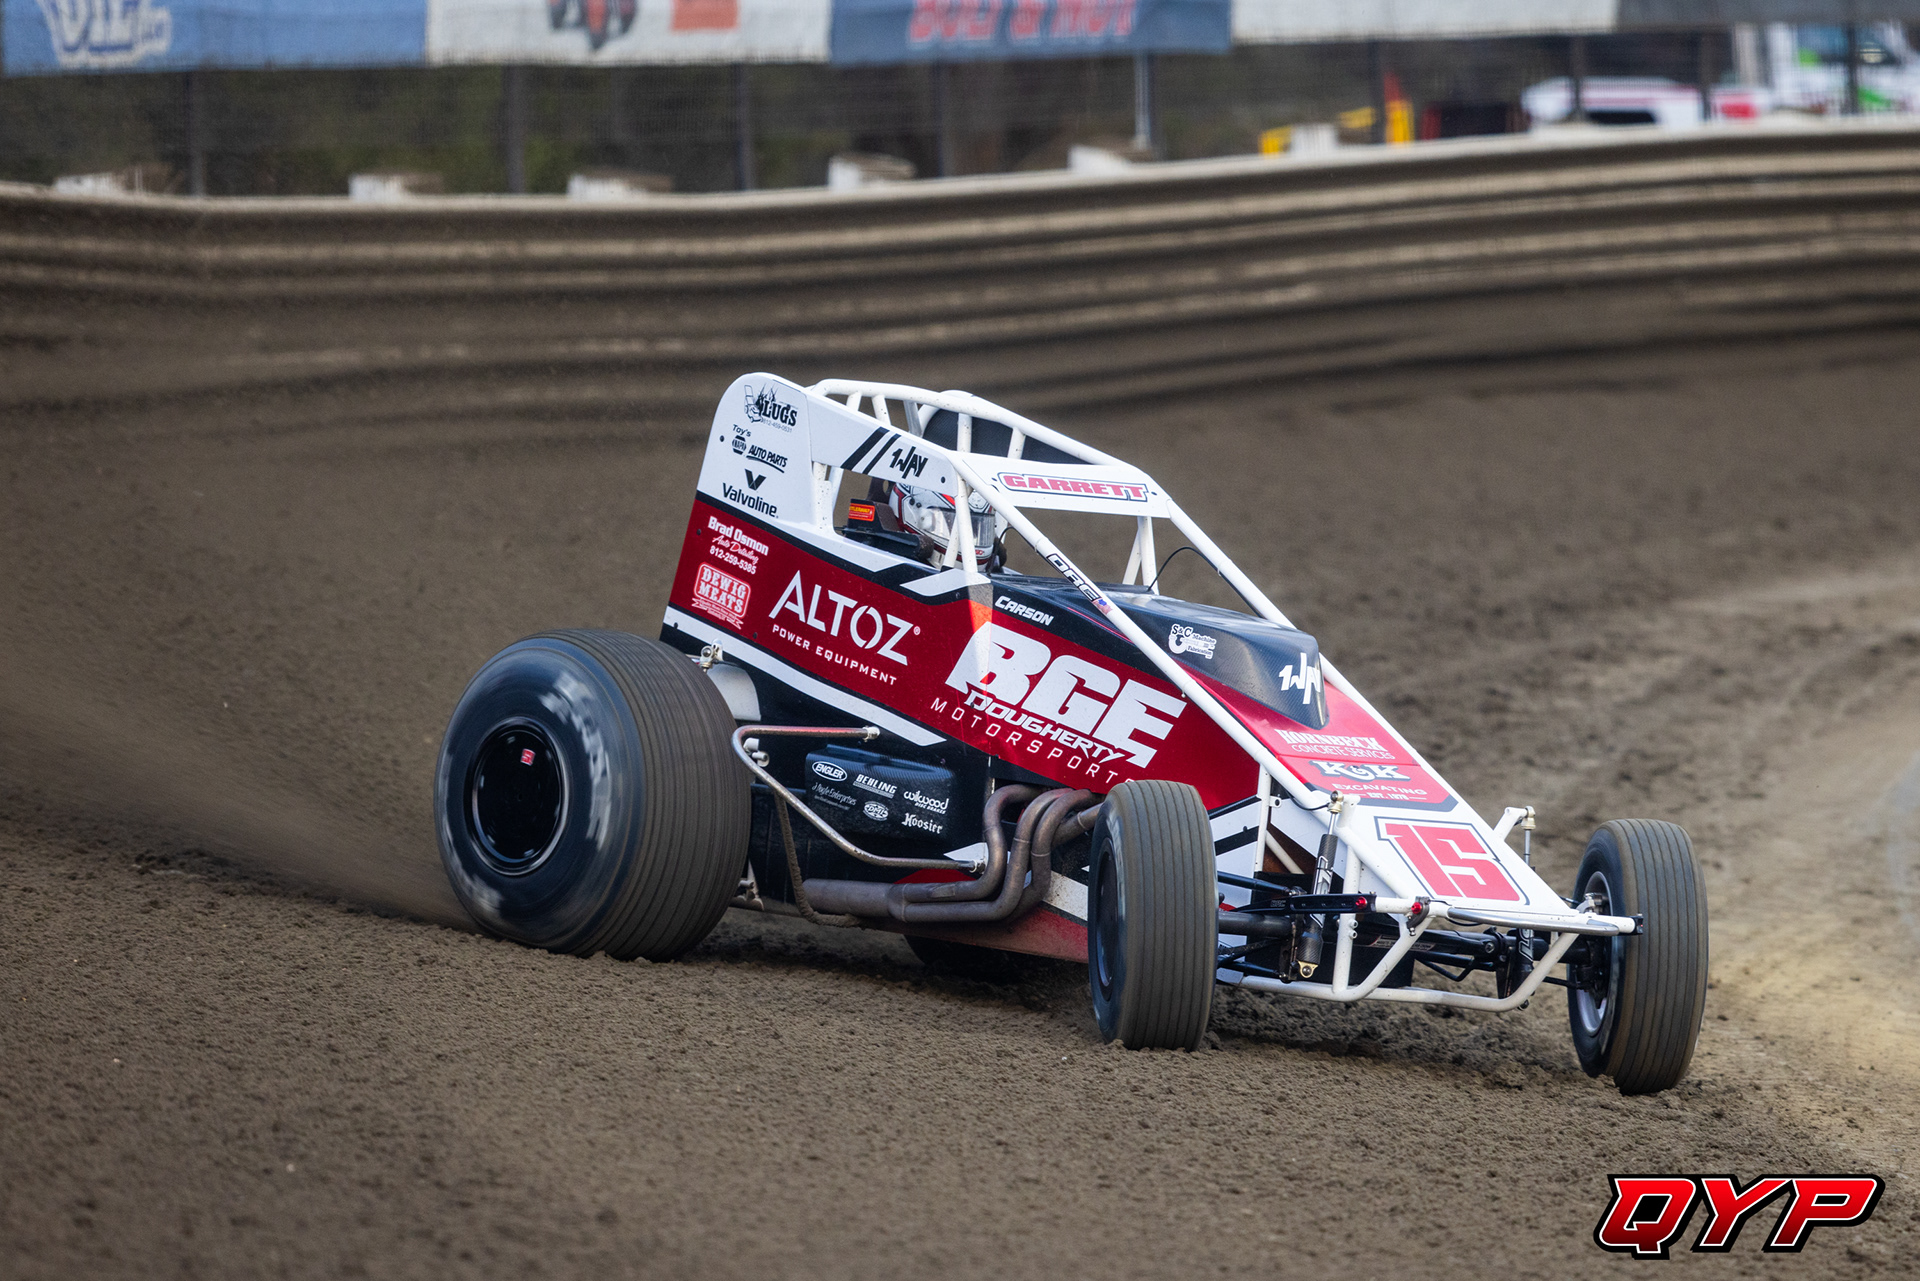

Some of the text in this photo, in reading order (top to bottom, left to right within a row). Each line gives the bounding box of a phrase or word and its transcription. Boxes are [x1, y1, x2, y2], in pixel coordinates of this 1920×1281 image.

[732, 424, 752, 438] Toy's
[747, 444, 766, 460] AUTO
[766, 451, 788, 468] PARTS
[1002, 474, 1146, 500] GARRETT
[722, 482, 778, 518] Valvoline
[707, 515, 769, 556] Brad Osmon
[712, 534, 731, 548] Auto
[701, 567, 747, 600] DEWIG
[697, 581, 744, 614] MEATS
[994, 595, 1055, 626] CARSON
[1171, 624, 1192, 638] S&C
[772, 623, 898, 686] POWER EQUIPMENT
[944, 621, 1188, 769] BGE
[963, 690, 1126, 764] DOUGHERTY
[1274, 728, 1389, 752] HORNBECK
[1291, 744, 1396, 760] CONCRETE SERVICES
[815, 763, 844, 779] ENGLER
[1308, 760, 1412, 783] K&K
[855, 773, 898, 794] BEHLING
[1331, 783, 1428, 796] EXCAVATING
[903, 790, 949, 810] wilwood
[901, 812, 943, 835] Hoosier
[1382, 821, 1523, 903] 15
